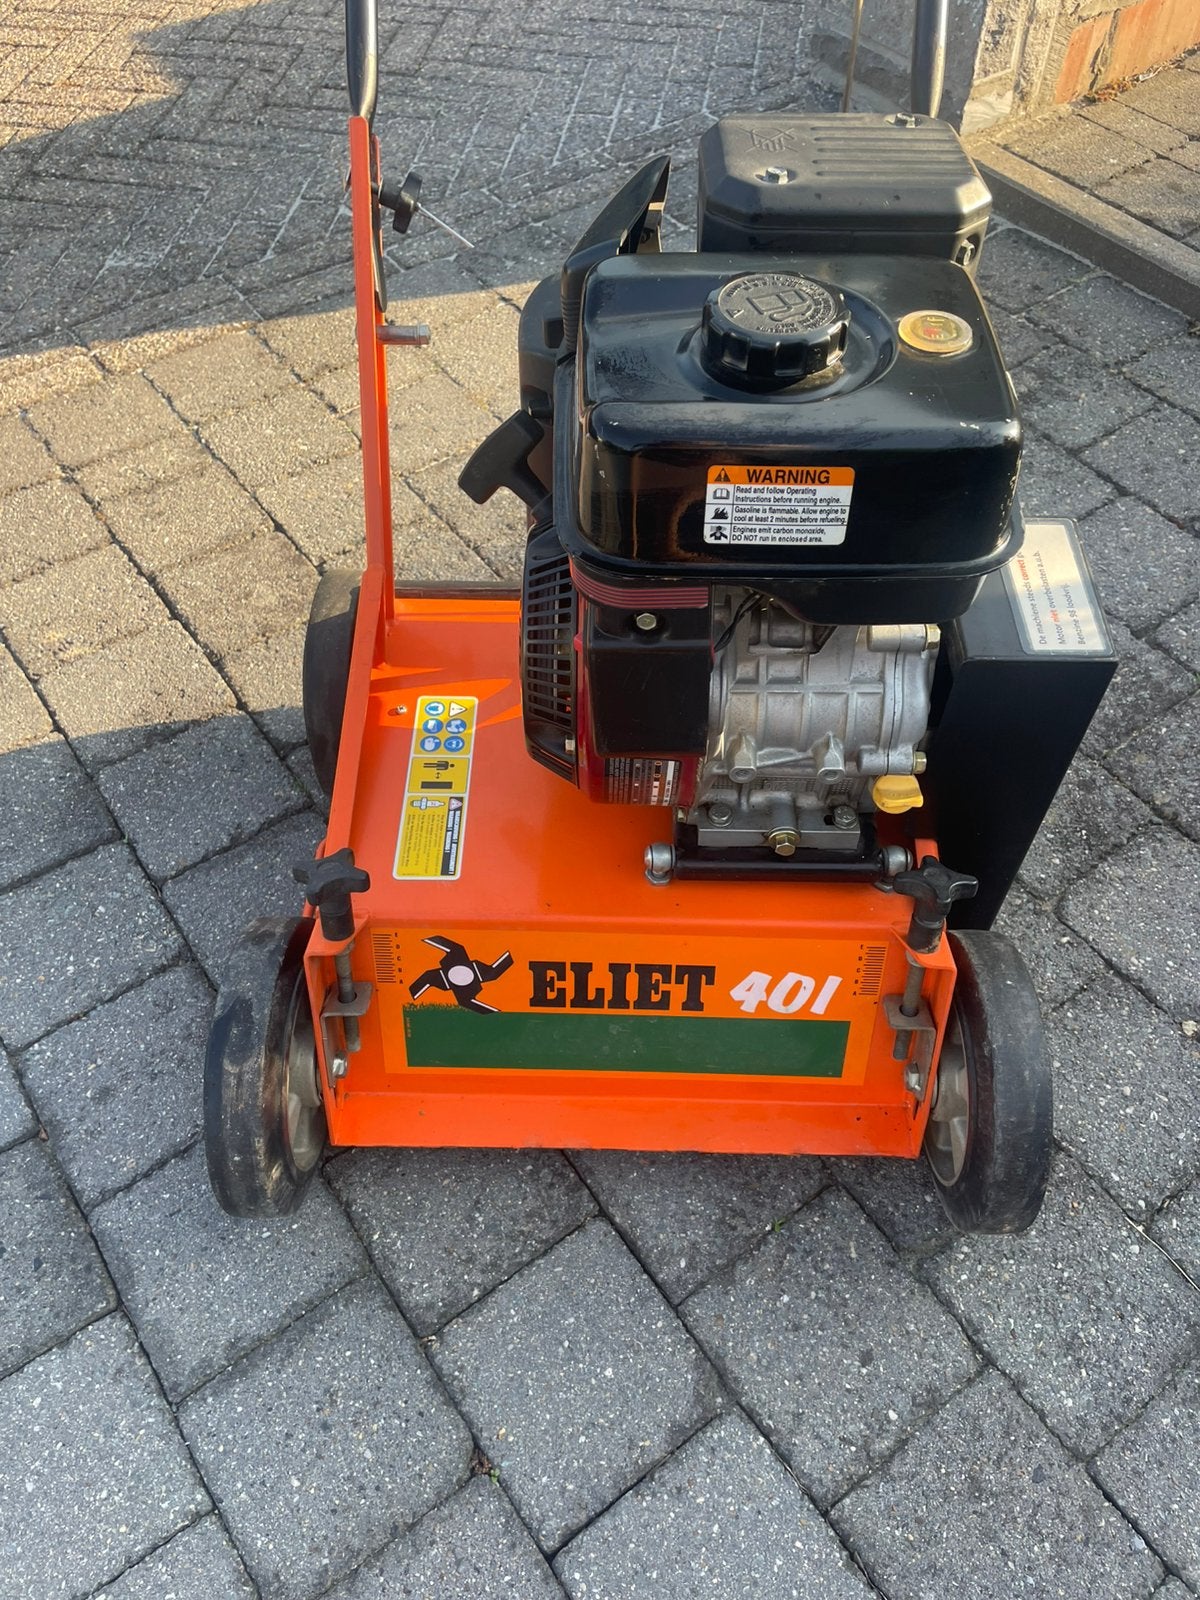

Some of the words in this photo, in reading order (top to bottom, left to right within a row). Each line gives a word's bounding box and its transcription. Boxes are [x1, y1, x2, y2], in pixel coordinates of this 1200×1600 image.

[746, 468, 830, 484] WARNING
[753, 486, 764, 494] and
[786, 487, 816, 496] Operating
[794, 496, 818, 505] running
[819, 497, 842, 505] engine.
[819, 508, 838, 516] engine
[819, 516, 846, 524] refueling.
[732, 526, 758, 534] Engines
[1050, 610, 1060, 622] niet
[1055, 624, 1066, 645] Motor
[529, 960, 716, 1011] ELIET
[730, 971, 842, 1015] 401
